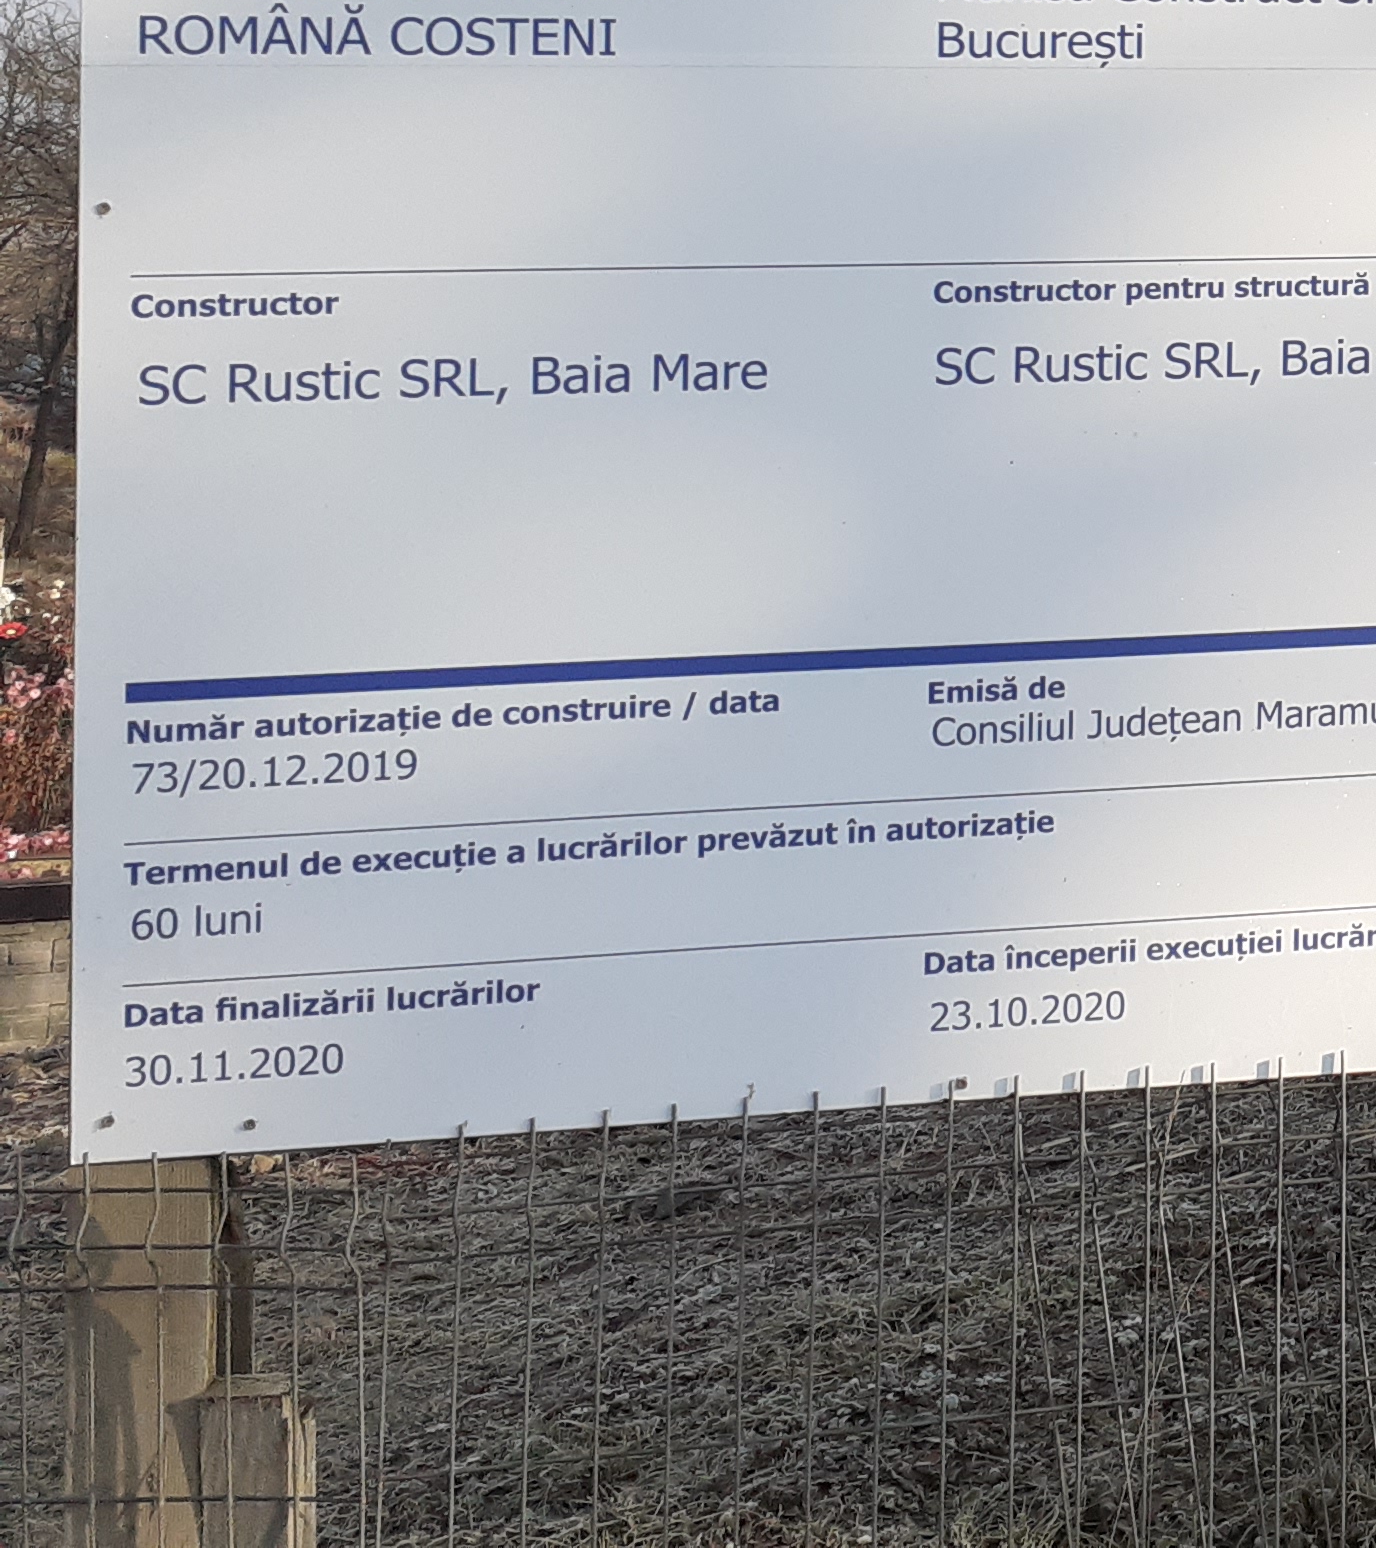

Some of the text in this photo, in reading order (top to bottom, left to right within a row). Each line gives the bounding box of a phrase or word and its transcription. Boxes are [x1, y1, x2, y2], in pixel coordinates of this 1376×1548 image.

[139, 2, 617, 57] ROMÂNĂ COSTENI
[937, 21, 1144, 69] București
[130, 292, 340, 319] Constructor
[933, 271, 1370, 306] Constructor pentru structură
[138, 353, 768, 406] SC Rustic SRL, Baia Mare
[935, 346, 996, 386] SC
[1014, 343, 1148, 384] Rustic
[1164, 341, 1261, 386] SRL,
[1282, 338, 1370, 377] Baia
[928, 675, 1066, 705] Emisă de
[126, 689, 780, 745] Număr autorizație de construire / data
[931, 709, 1074, 747] Consiliul
[1086, 705, 1242, 743] Județean
[132, 748, 418, 799] 73/20.12.2019
[123, 809, 1055, 887] Termenul de execuție a lucrărilor prevăzut în autorizație
[131, 902, 262, 941] 60 luni
[923, 949, 995, 976] Data
[1004, 938, 1137, 972] începerii
[1146, 929, 1283, 962] execuției
[124, 978, 541, 1029] Data finalizării lucrărilor
[930, 990, 1125, 1032] 23.10.2020
[125, 1043, 344, 1088] 30.11.2020
